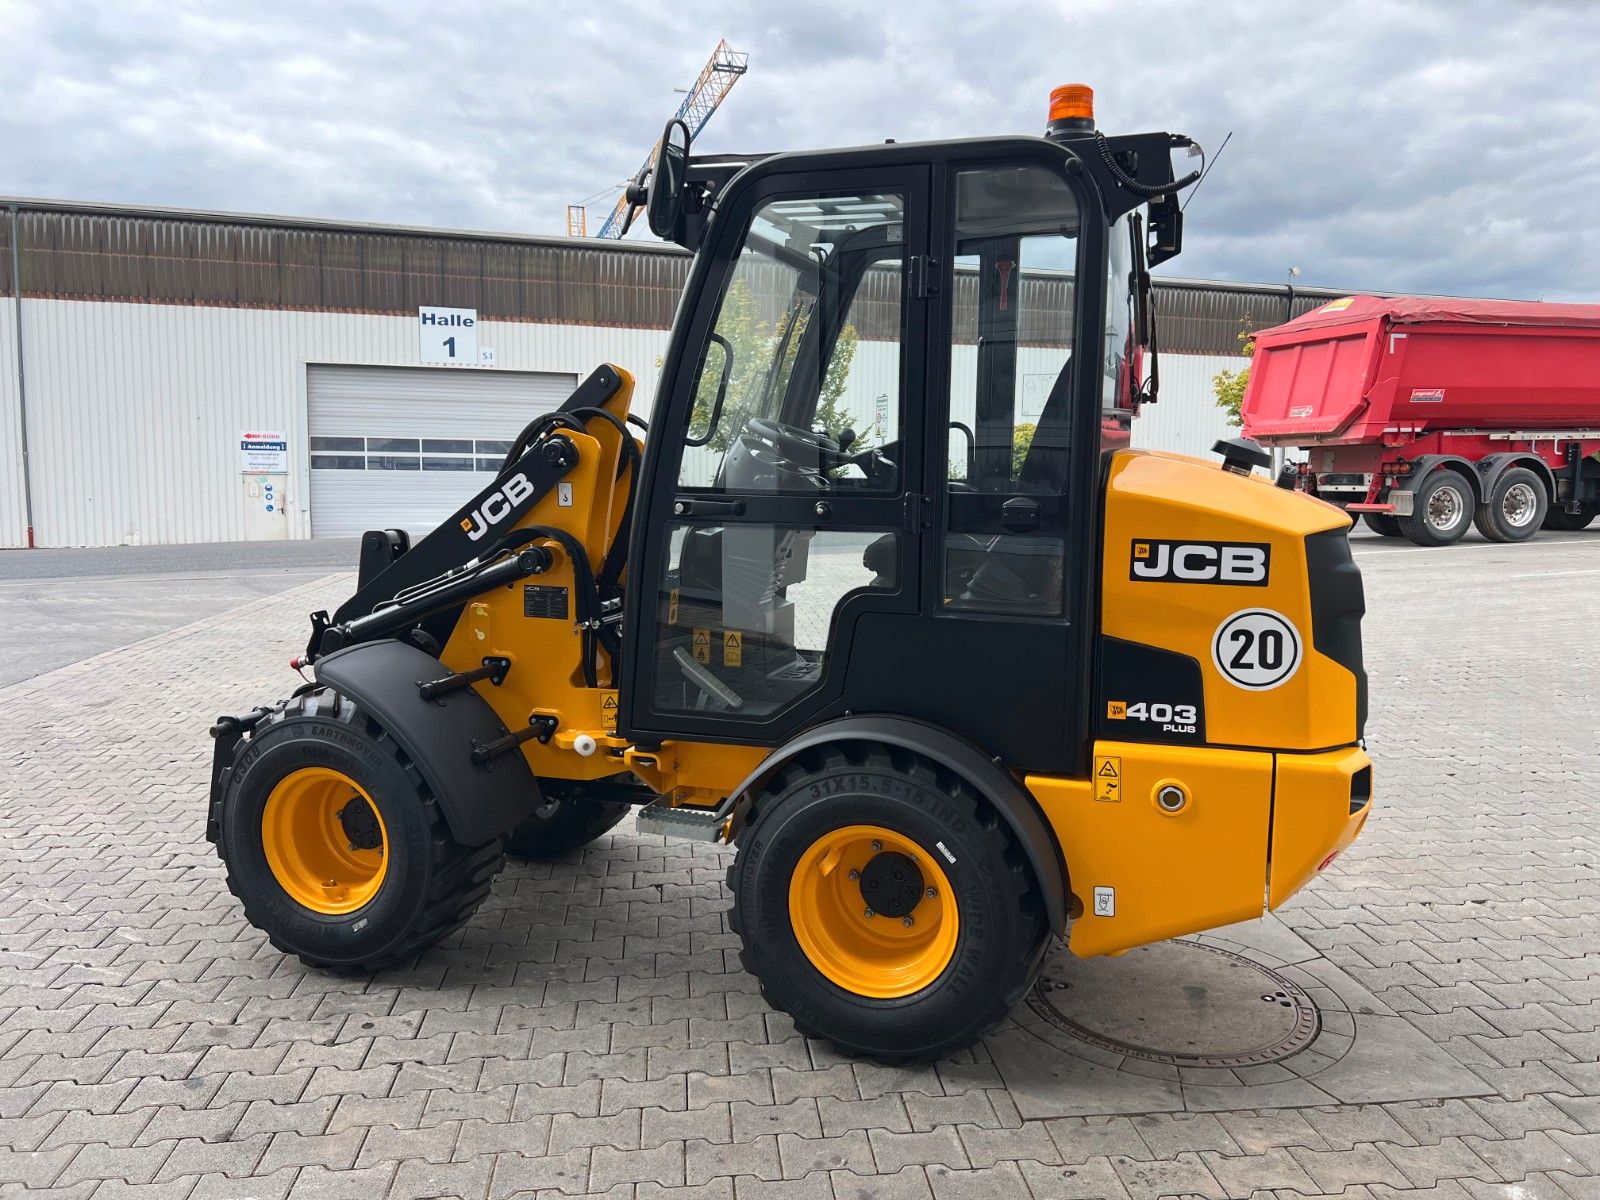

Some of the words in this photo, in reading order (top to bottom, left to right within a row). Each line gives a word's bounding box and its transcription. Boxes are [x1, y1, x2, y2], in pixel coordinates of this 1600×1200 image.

[422, 313, 474, 327] Halle
[443, 336, 455, 357] 1
[467, 473, 534, 541] JCB
[1133, 544, 1266, 582] JCB
[1230, 629, 1283, 670] 20
[1126, 702, 1197, 724] 403
[1163, 724, 1196, 733] PLUS
[311, 726, 384, 768] EARTHMOVER
